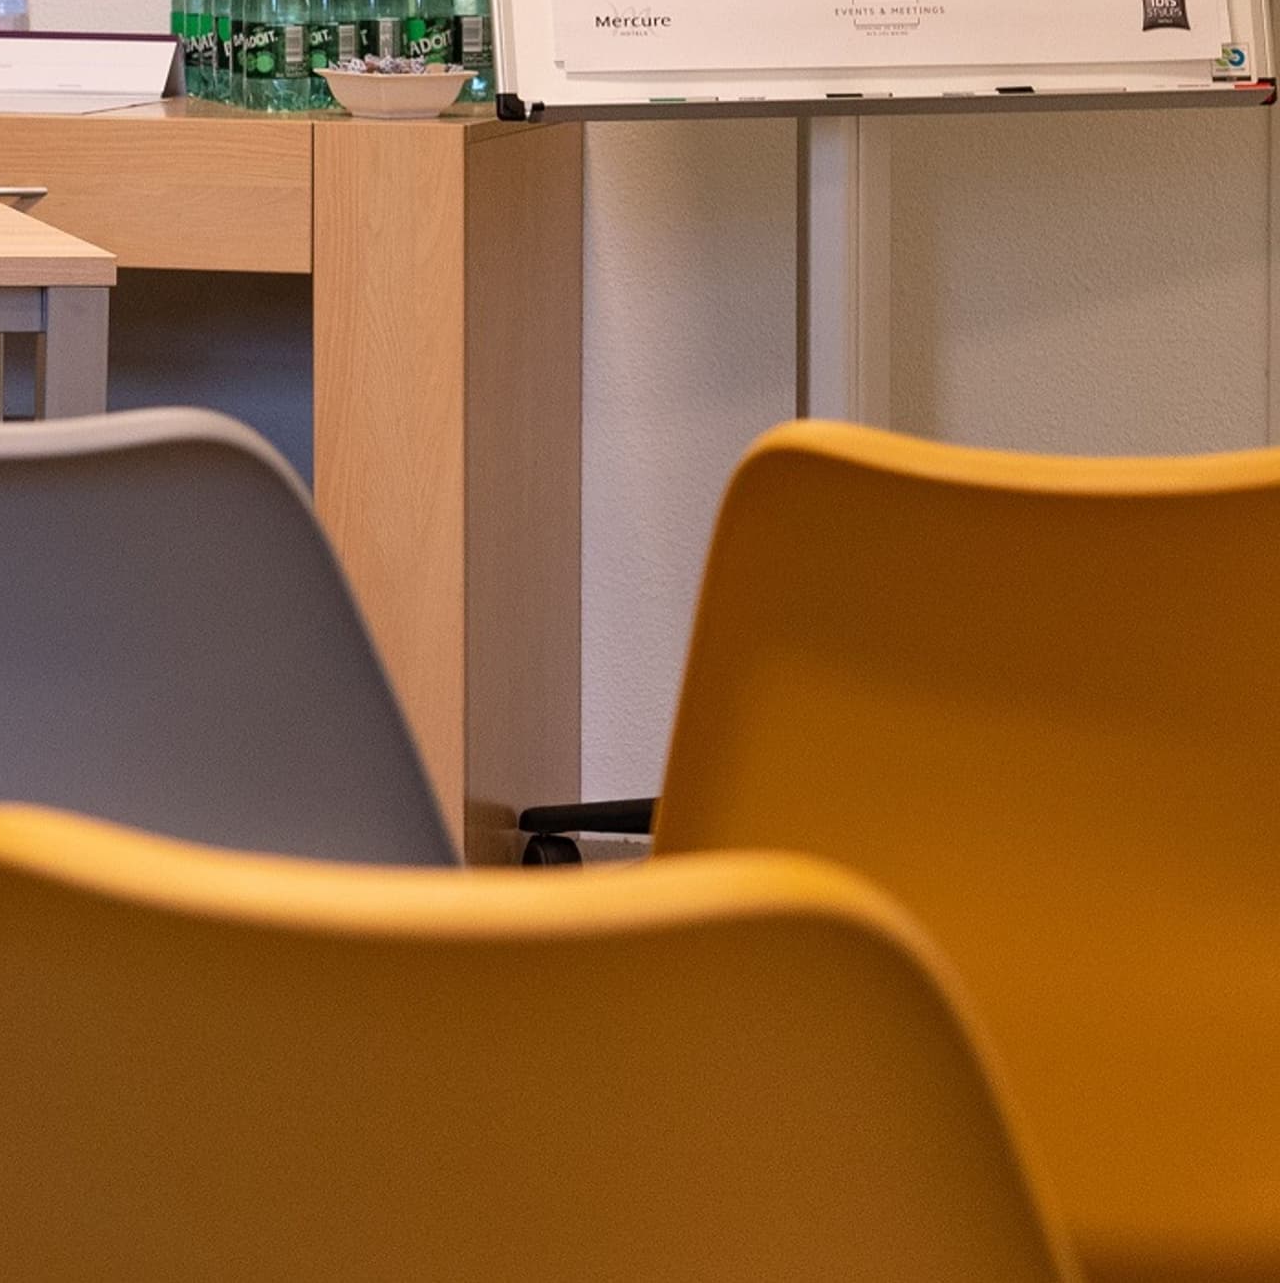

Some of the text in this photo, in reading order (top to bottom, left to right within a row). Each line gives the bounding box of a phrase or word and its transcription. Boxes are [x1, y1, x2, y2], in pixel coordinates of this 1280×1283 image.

[834, 5, 945, 16] EVENTS & MEETINGS
[595, 15, 671, 29] Mercure
